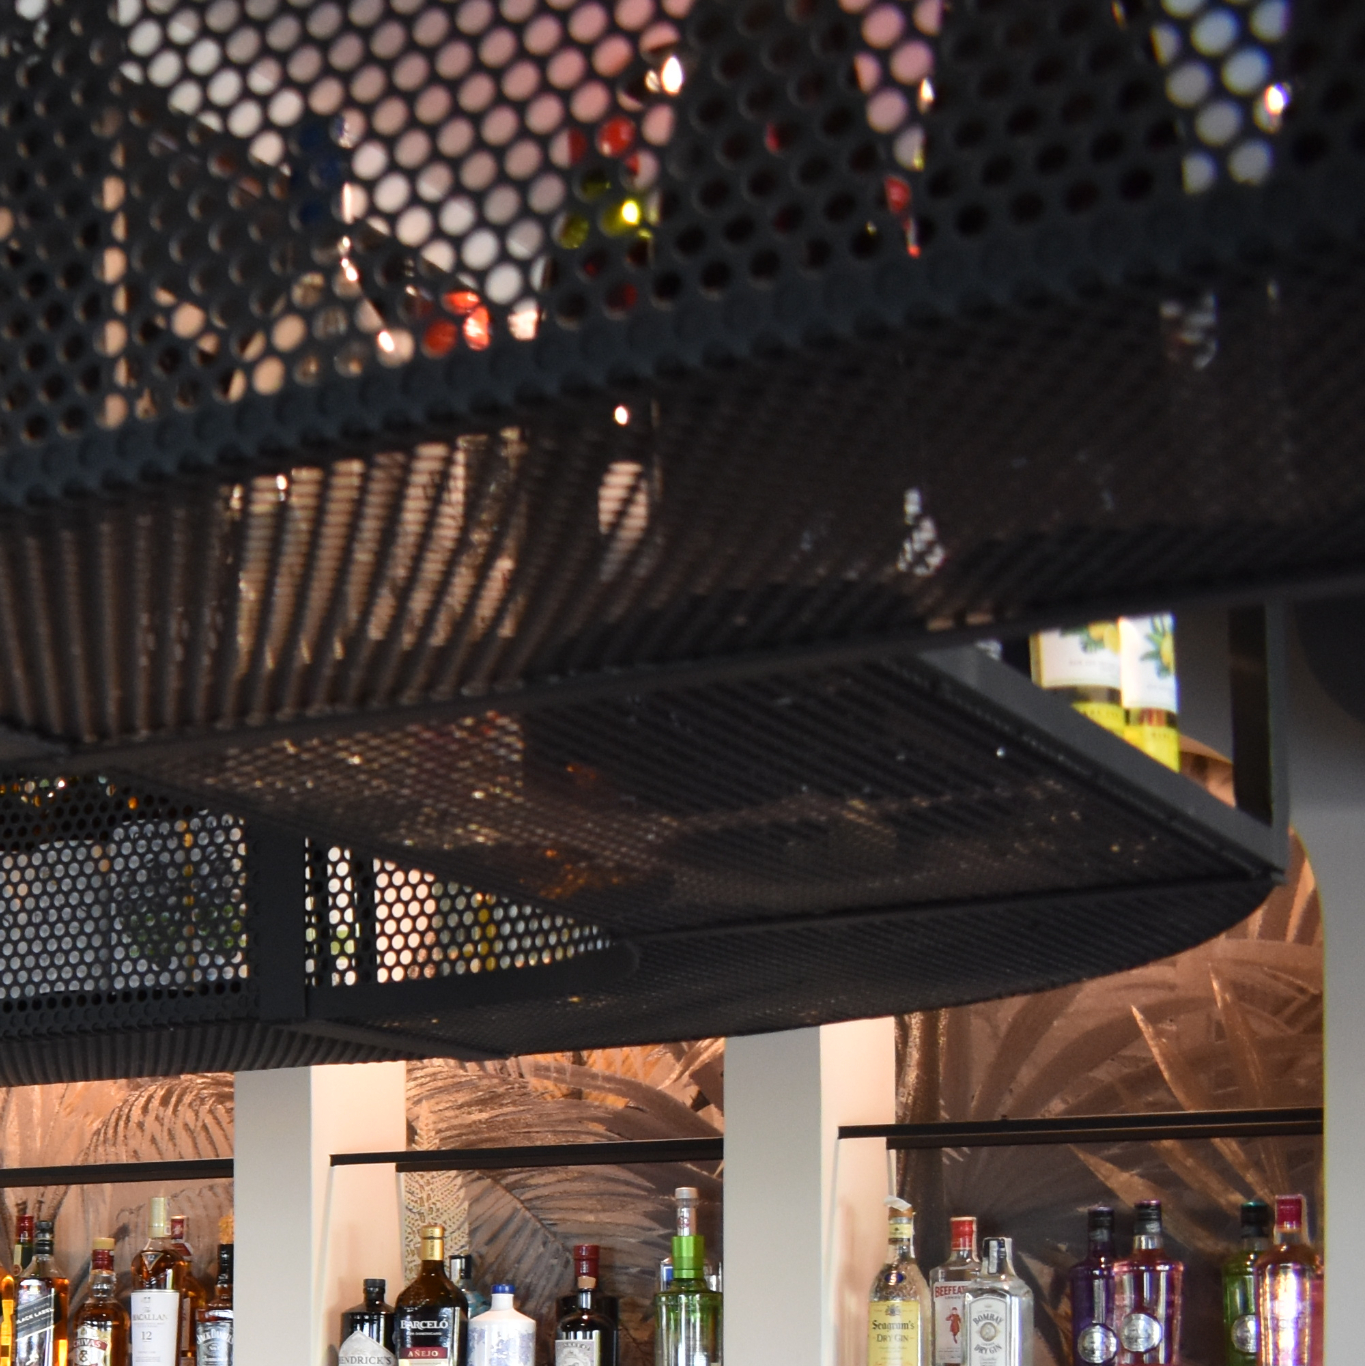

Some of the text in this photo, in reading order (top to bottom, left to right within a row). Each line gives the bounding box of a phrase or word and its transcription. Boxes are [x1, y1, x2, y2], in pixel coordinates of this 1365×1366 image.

[935, 1286, 969, 1298] BEEFEAT
[400, 1318, 449, 1331] BARCELÓ
[972, 1313, 1004, 1326] BOMBAY
[872, 1319, 915, 1332] Seagram's
[141, 1331, 152, 1341] 12
[876, 1334, 909, 1342] DRY GIN
[407, 1348, 439, 1358] AÑEJO
[974, 1343, 1003, 1354] DRY GIN
